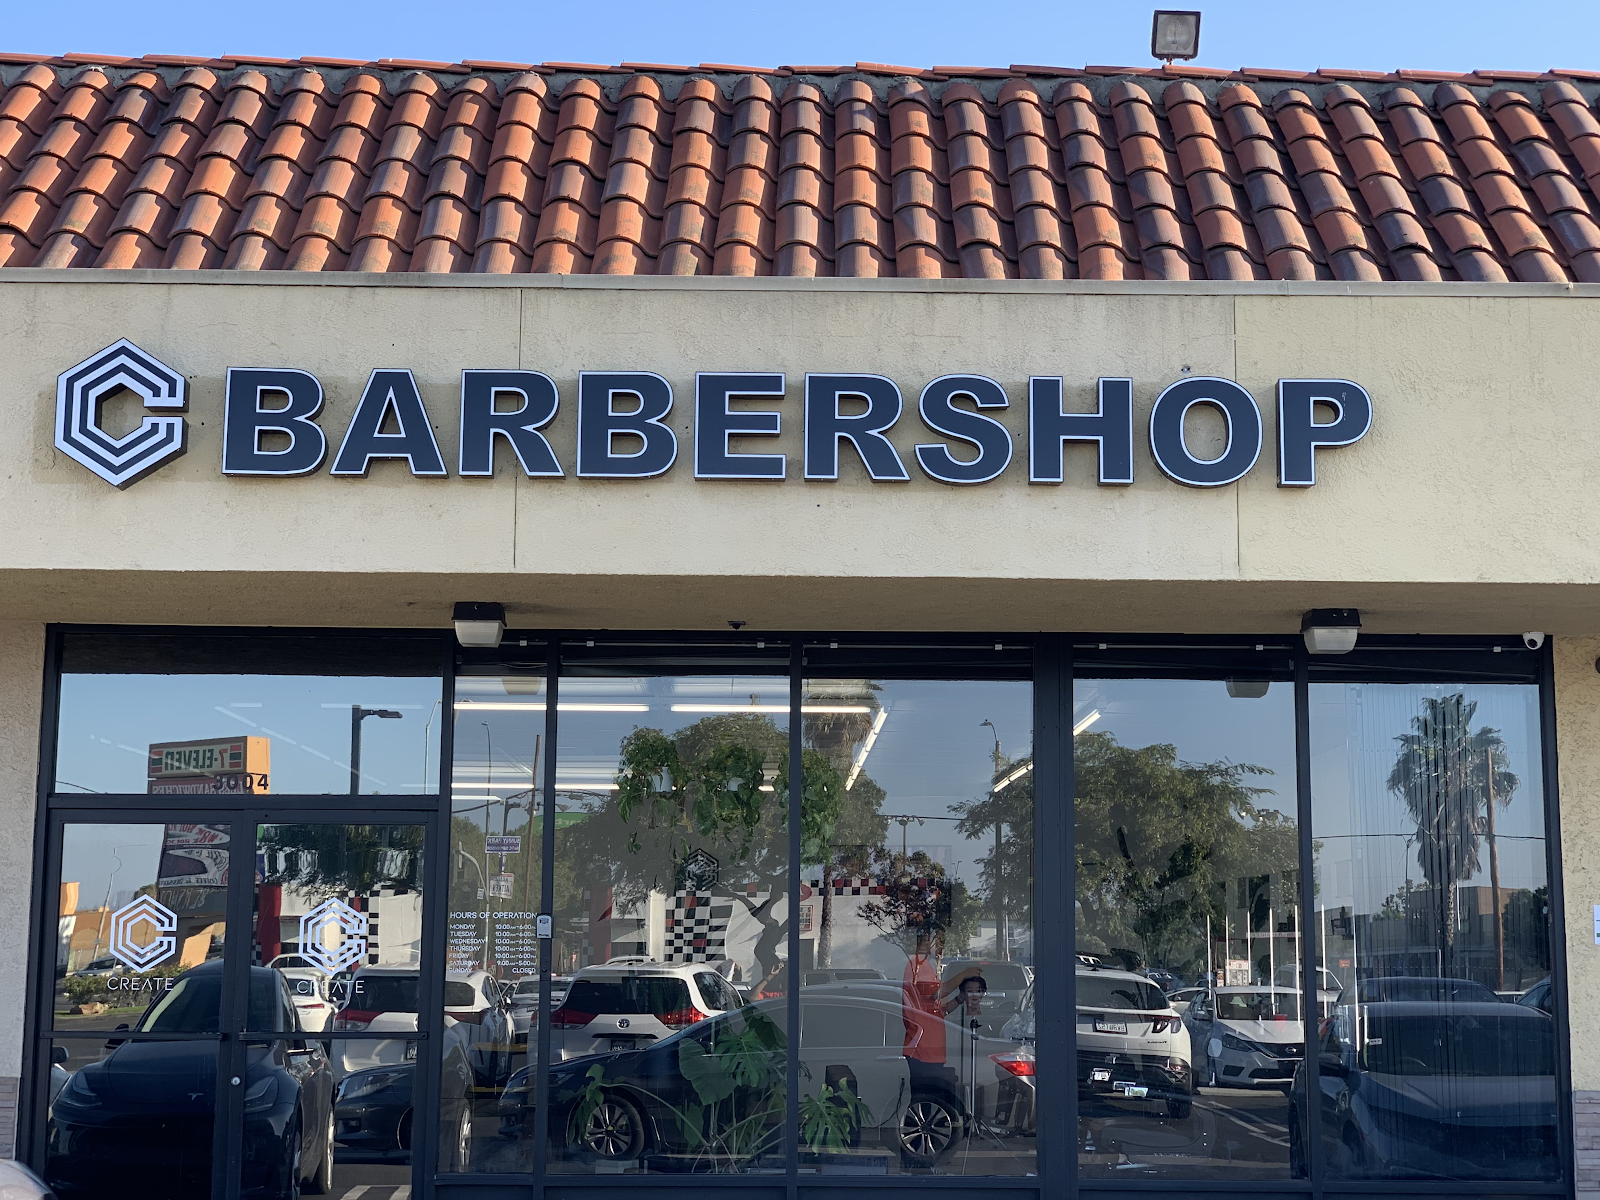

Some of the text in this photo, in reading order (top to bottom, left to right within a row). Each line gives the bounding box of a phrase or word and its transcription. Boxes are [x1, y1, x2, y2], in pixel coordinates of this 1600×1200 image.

[221, 366, 1373, 488] BARBERSHOP
[212, 773, 269, 791] 3004
[449, 911, 538, 919] HOURS OF OPERATION
[106, 977, 175, 991] CREATE
[296, 980, 365, 994] CREATE
